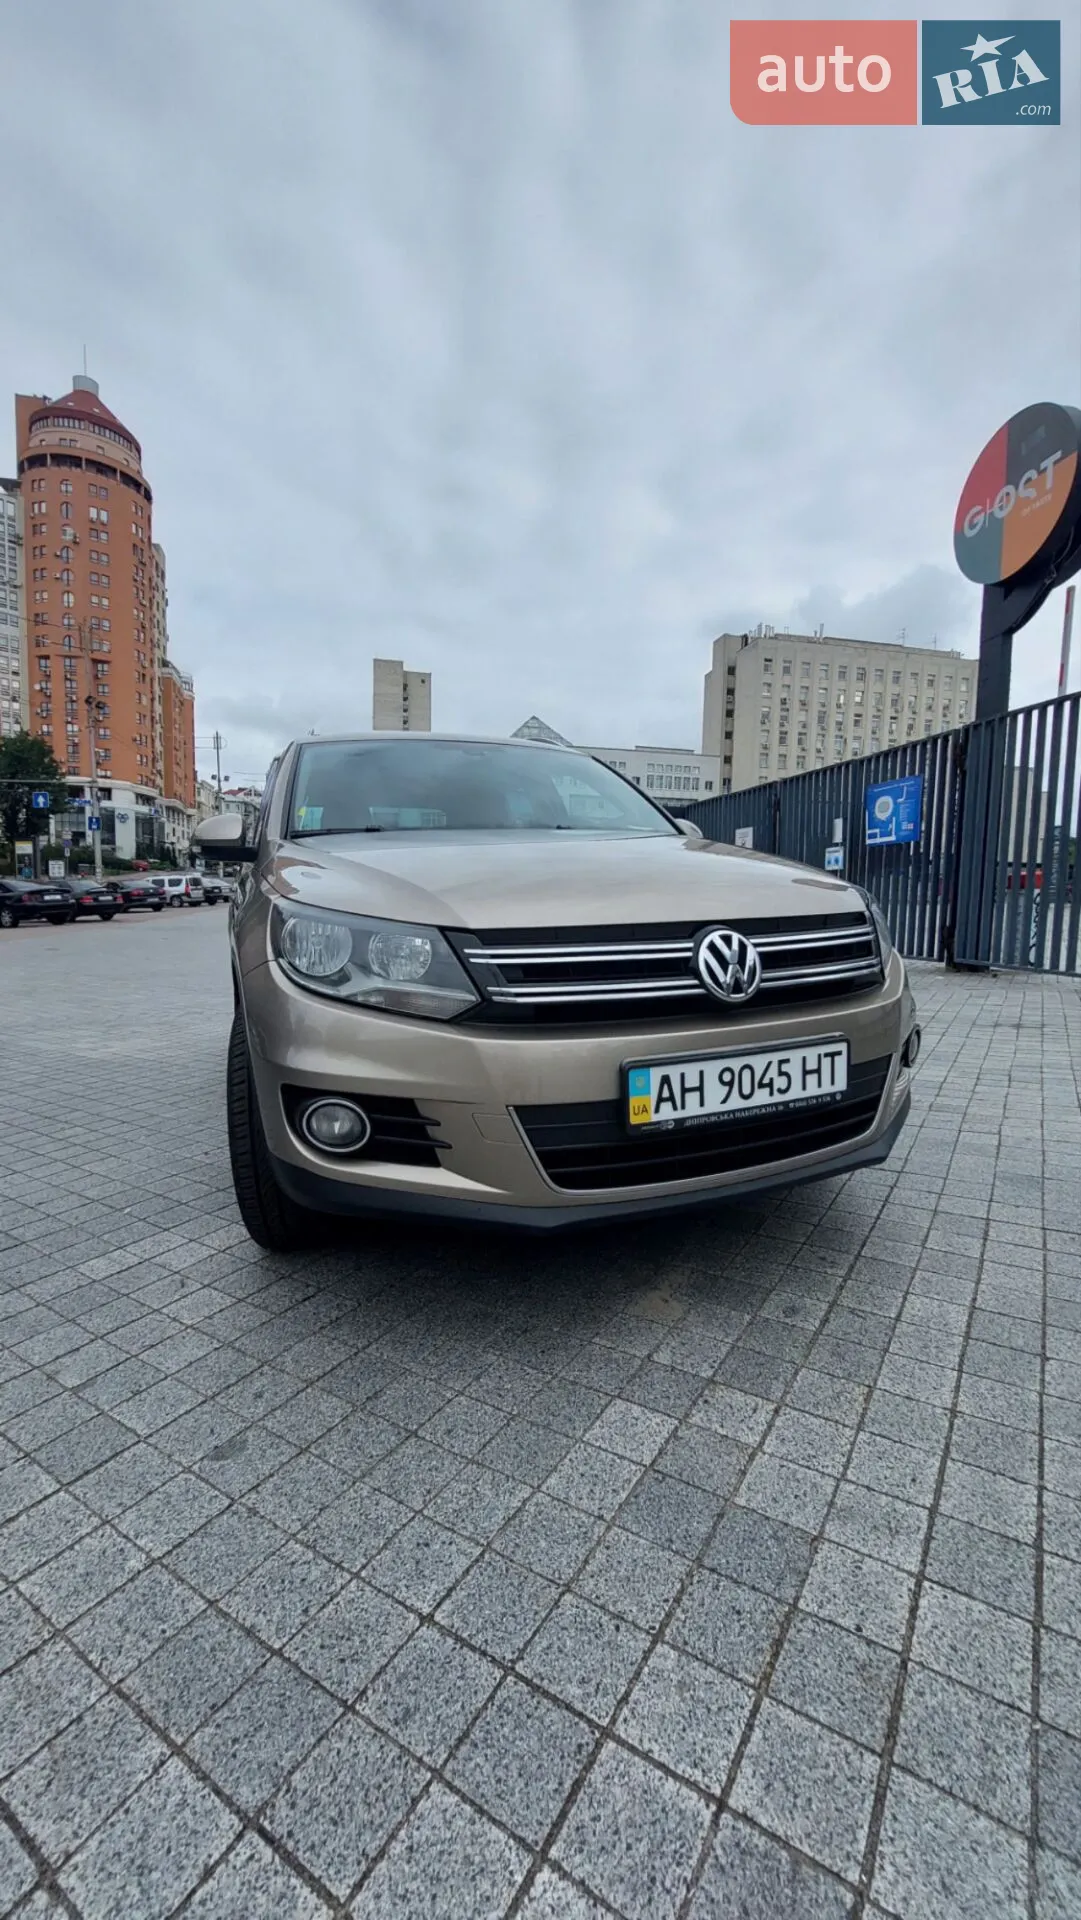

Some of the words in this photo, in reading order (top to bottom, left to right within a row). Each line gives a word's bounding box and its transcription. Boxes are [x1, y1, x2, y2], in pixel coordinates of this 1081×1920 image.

[654, 1069, 705, 1115] AH
[718, 1058, 792, 1105] 9045
[801, 1050, 843, 1091] HT
[632, 1105, 649, 1117] UA
